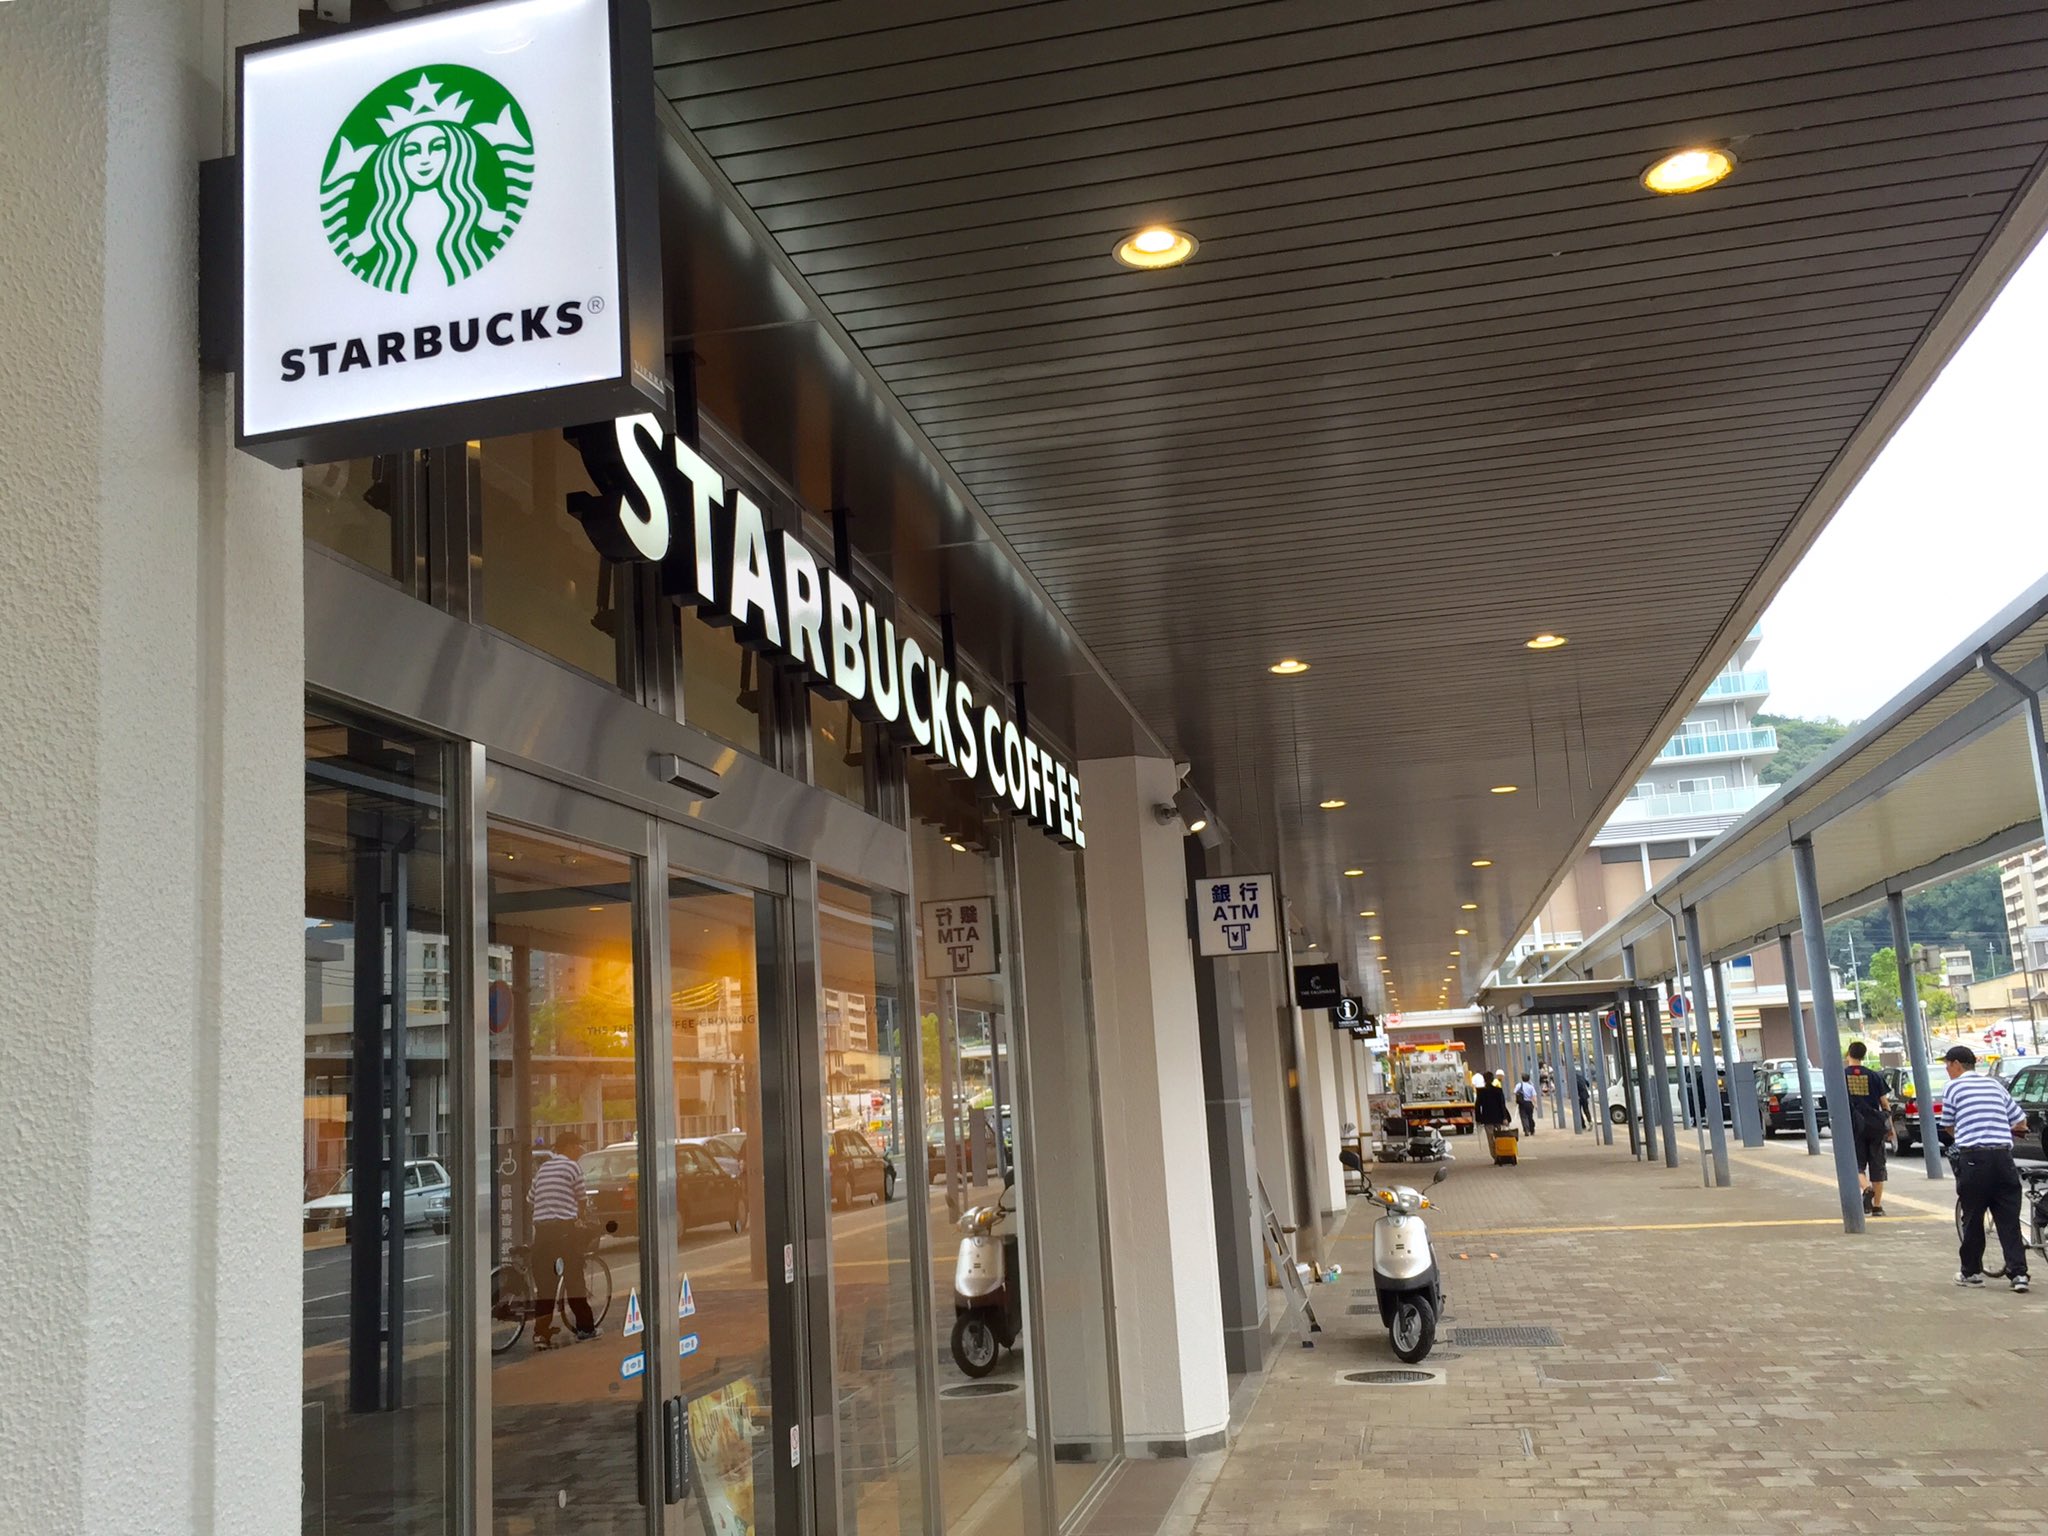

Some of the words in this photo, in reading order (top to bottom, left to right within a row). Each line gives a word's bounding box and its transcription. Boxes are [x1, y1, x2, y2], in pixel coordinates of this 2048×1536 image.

[281, 300, 583, 382] STARBUCKS
[615, 411, 977, 779] STARBUCKS
[983, 704, 1086, 849] COFFEE
[1211, 882, 1259, 904] 銀行
[1213, 903, 1259, 921] ATM
